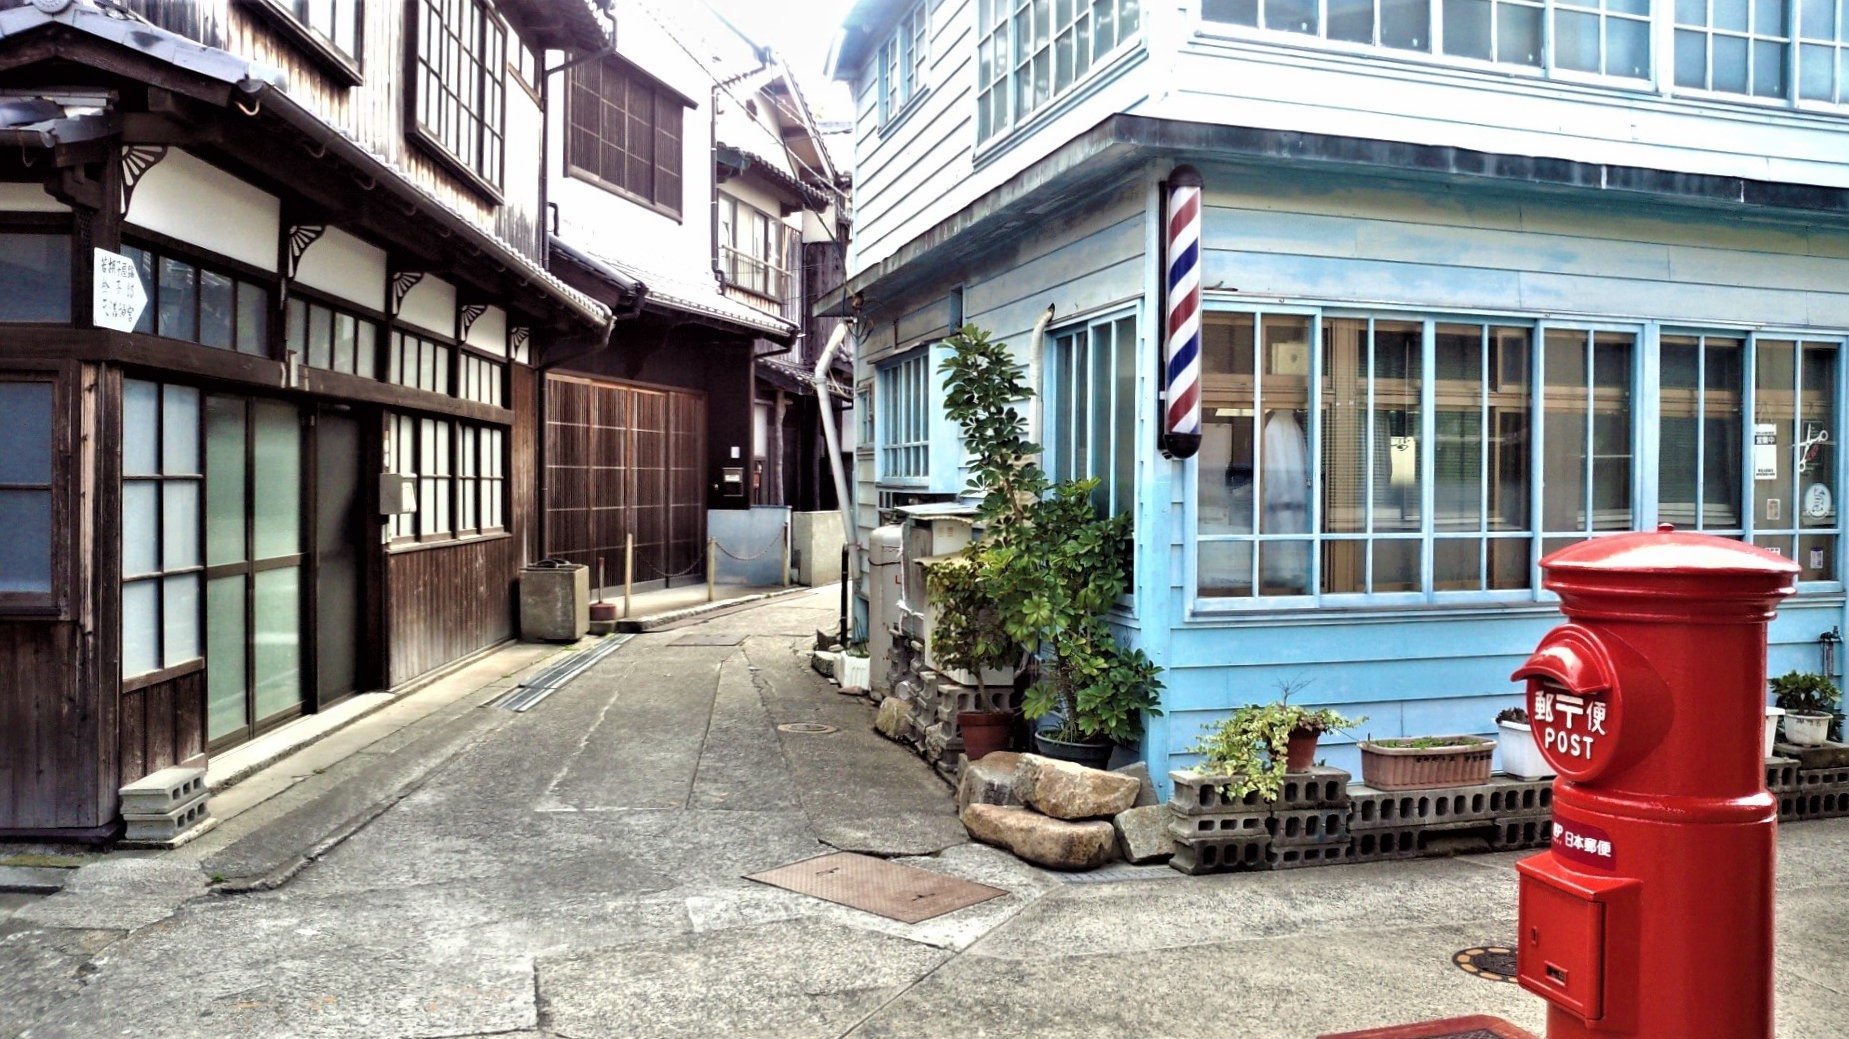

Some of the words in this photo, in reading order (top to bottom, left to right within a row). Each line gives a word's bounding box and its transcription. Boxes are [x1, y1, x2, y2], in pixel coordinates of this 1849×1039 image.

[1544, 727, 1594, 760] POST
[1565, 831, 1612, 858] 日本郵便
